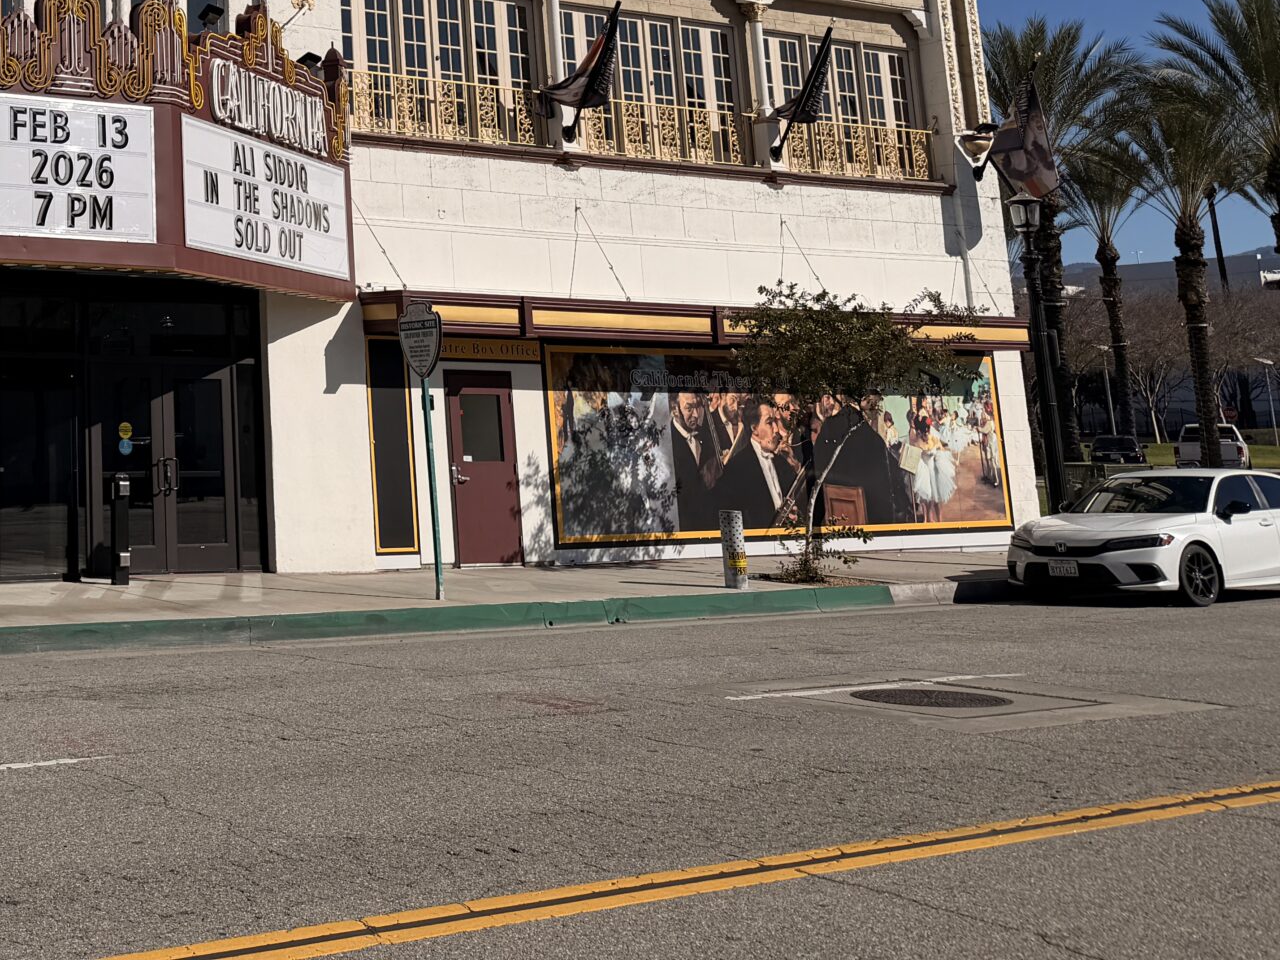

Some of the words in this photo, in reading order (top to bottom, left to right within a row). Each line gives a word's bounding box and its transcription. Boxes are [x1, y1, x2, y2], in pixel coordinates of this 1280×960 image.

[9, 106, 70, 144] FEB
[97, 113, 129, 149] 13
[210, 58, 329, 158] CALIFORNIA
[31, 148, 114, 189] 2026
[233, 141, 256, 177] ALI
[264, 151, 308, 194] SIDDIQ
[34, 191, 54, 227] 7
[67, 192, 113, 231] PM
[203, 170, 219, 205] IN
[233, 177, 260, 214] THE
[272, 191, 331, 233] SHADOWS
[234, 215, 271, 255] SOLD
[279, 227, 304, 262] OUT
[400, 322, 424, 330] HISTORIC
[423, 320, 436, 328] SITE
[441, 343, 466, 354] atre
[472, 343, 495, 355] Box
[500, 343, 538, 357] Office
[629, 368, 710, 388] California
